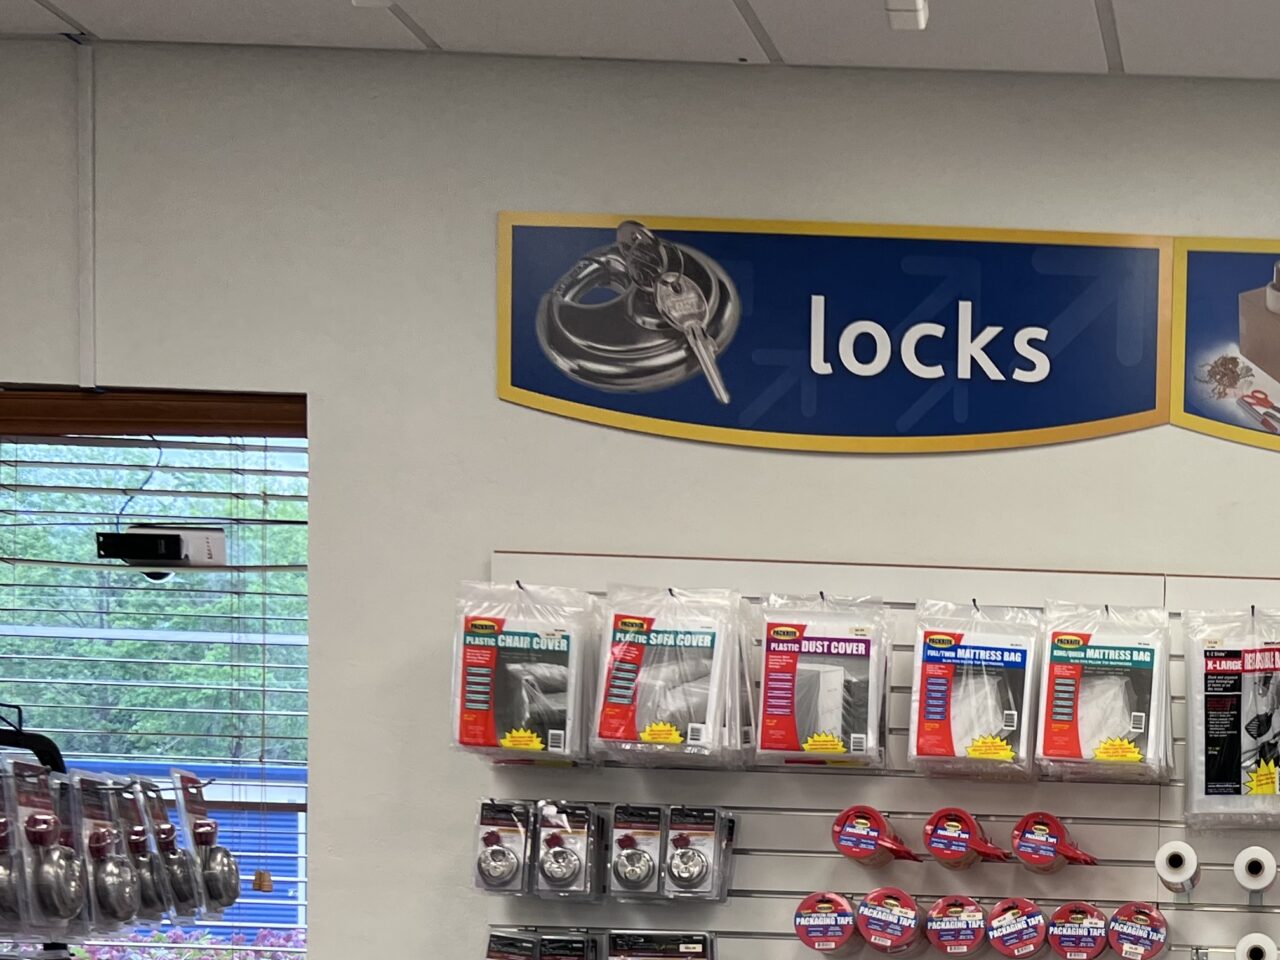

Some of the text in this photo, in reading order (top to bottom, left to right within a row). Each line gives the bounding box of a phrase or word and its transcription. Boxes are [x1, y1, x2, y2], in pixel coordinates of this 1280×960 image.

[810, 294, 1051, 383] locks
[466, 634, 568, 650] PLASTIC CHAIR COVER
[615, 632, 711, 647] PLASTIC SOFA COVER
[770, 641, 866, 655] PLASTIC DUST COVER
[957, 648, 1002, 661] MATTRESS
[1003, 651, 1022, 662] BAG
[1086, 648, 1131, 661] MATTRESS
[1132, 650, 1151, 662] BAG
[1207, 660, 1242, 671] X-LARGE
[796, 916, 853, 925] PACKAGING TAPE
[859, 906, 916, 928] PACKAGING TAPE
[927, 919, 985, 930] PACKAGING TAPE
[989, 915, 1044, 939] PACKAGING TAPE
[1049, 927, 1106, 937] PACKAGING TAPE
[1110, 921, 1165, 943] PACKAGING TAPE
